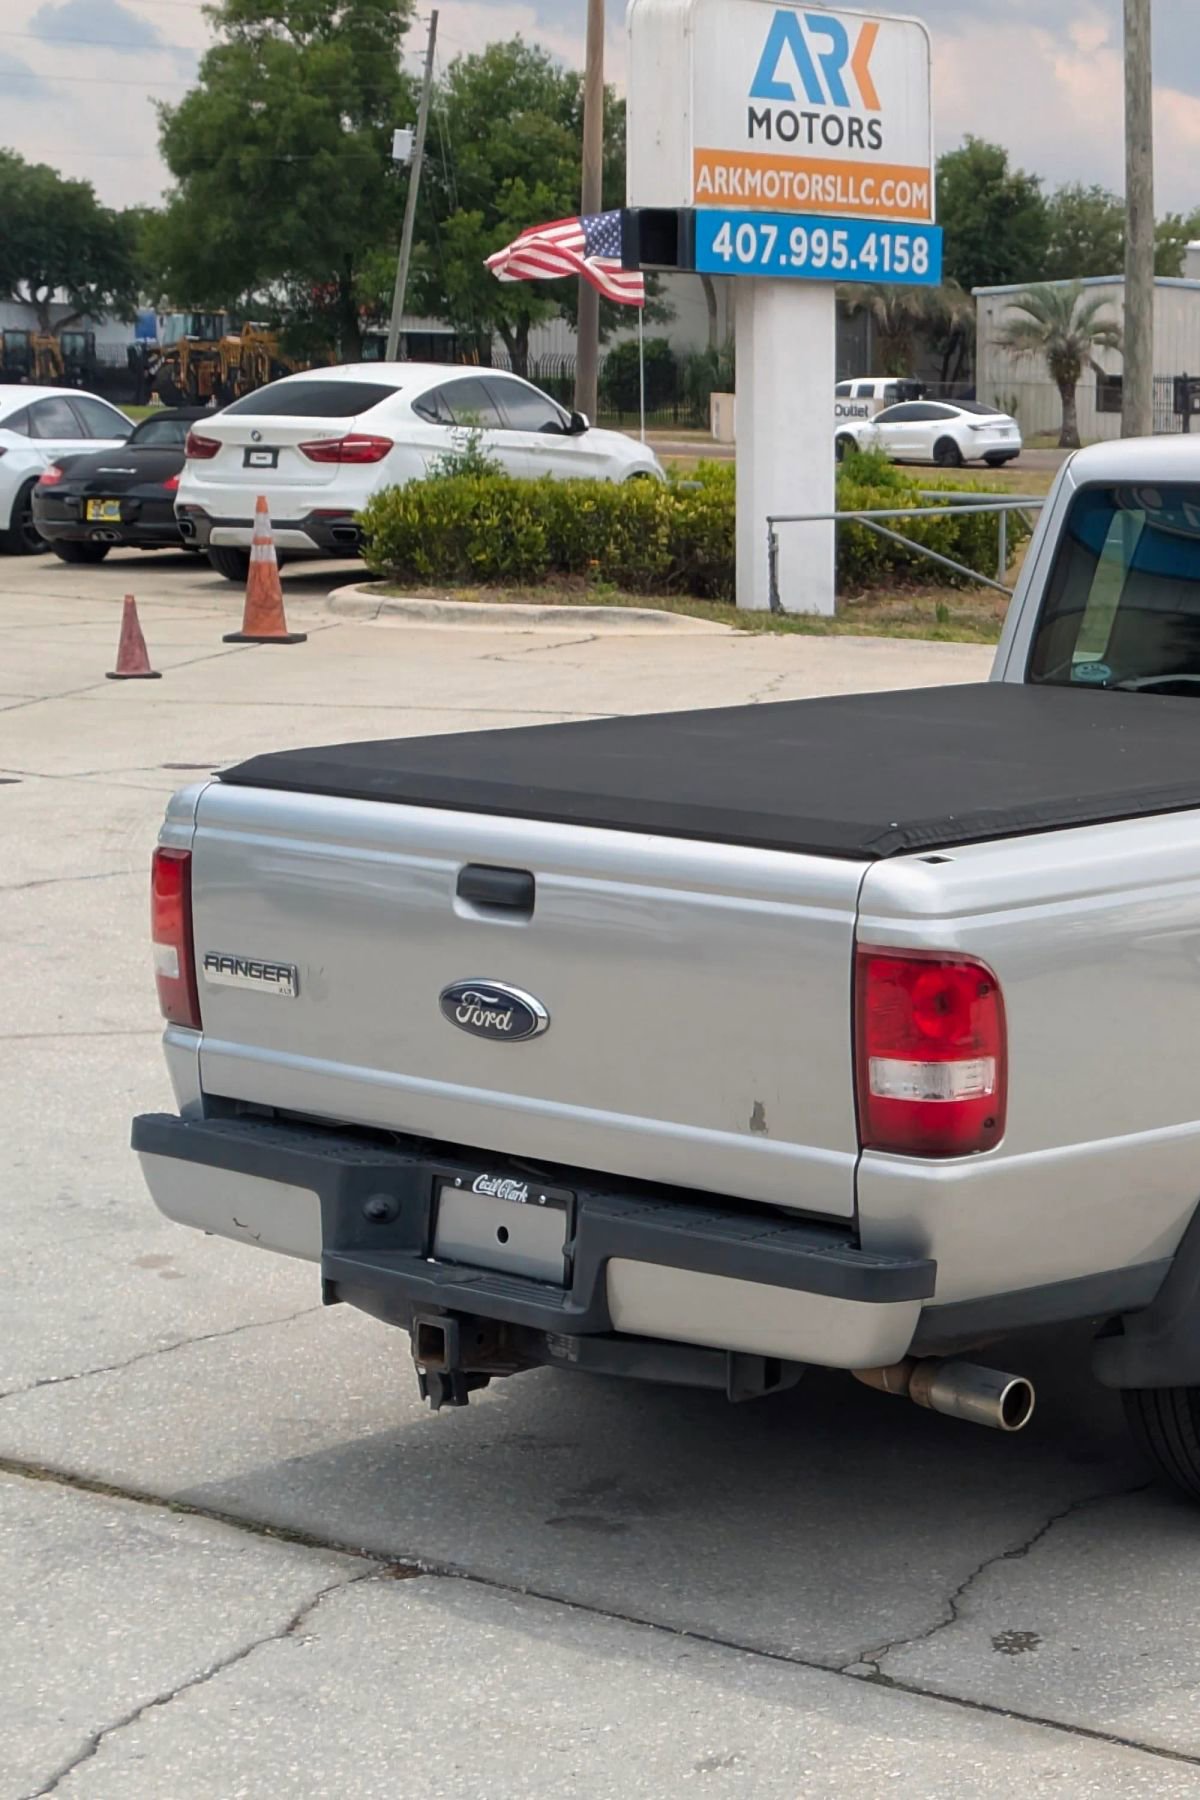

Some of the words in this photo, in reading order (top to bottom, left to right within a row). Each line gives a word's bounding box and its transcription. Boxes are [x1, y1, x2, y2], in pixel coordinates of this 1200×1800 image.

[748, 9, 882, 111] ARK
[748, 106, 882, 150] MOTORS
[696, 164, 928, 209] ARKMOTORSLLC.COM
[711, 221, 929, 275] 407.995.4158
[204, 954, 292, 985] RANGER
[456, 990, 513, 1031] Ford
